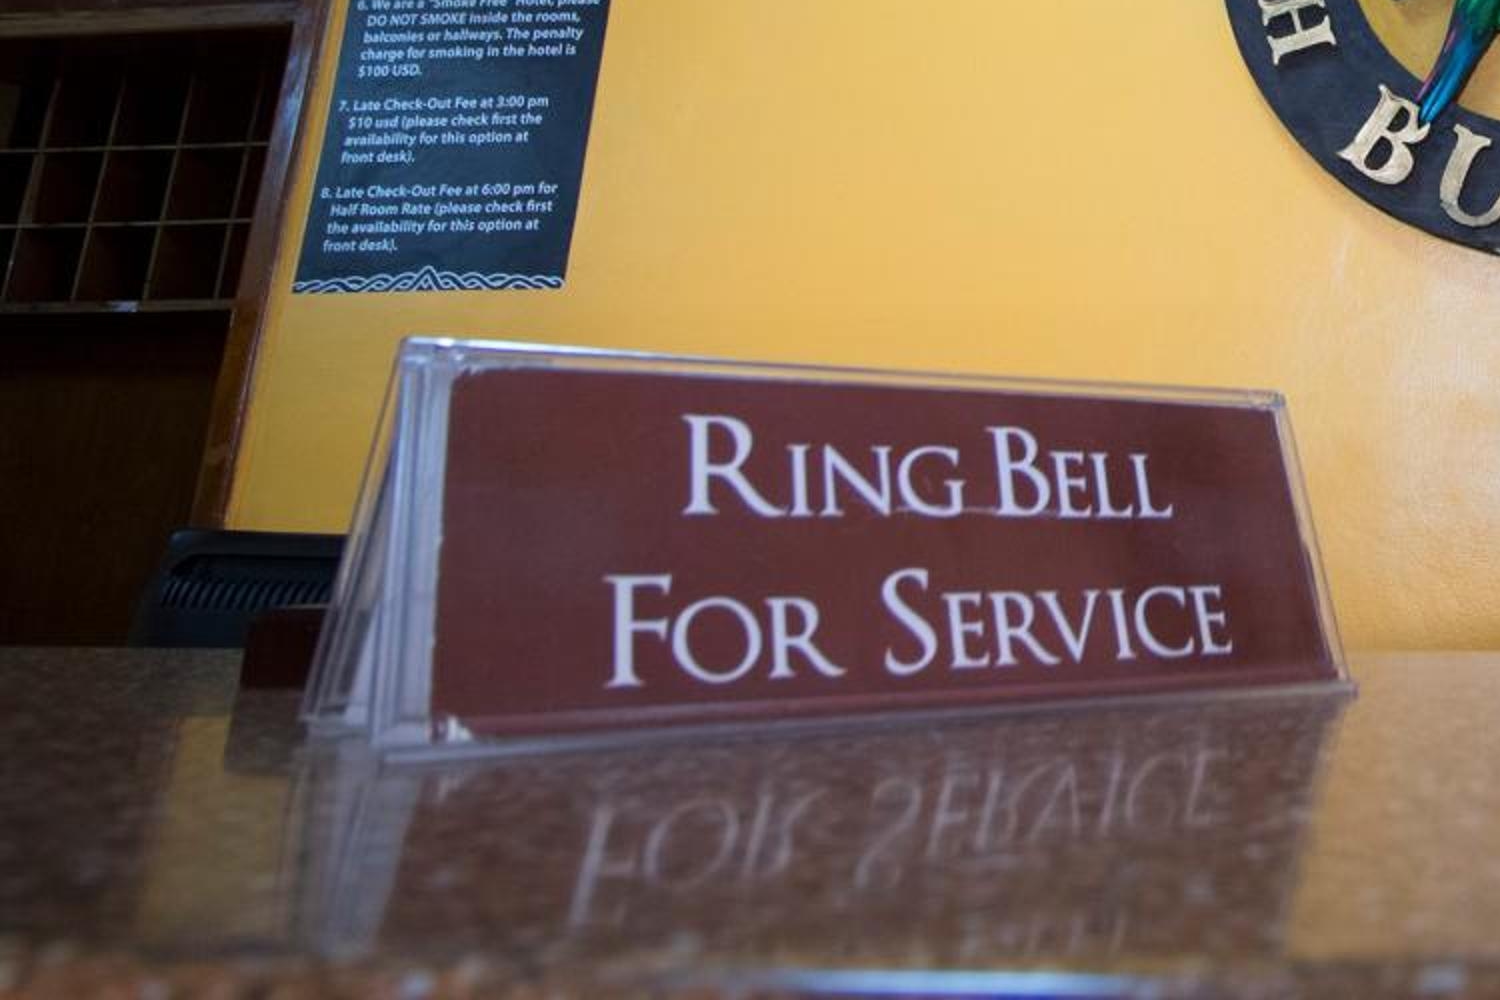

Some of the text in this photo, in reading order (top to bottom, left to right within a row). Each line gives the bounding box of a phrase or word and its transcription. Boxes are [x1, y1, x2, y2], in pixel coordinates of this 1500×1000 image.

[366, 11, 581, 27] DO NOT SMOKE inside the rooms,
[357, 63, 422, 79] $100 USD.
[338, 99, 350, 112] 7.
[352, 100, 382, 112] Late
[383, 97, 452, 111] Check-Out
[454, 96, 478, 109] Fee
[479, 96, 494, 109] at
[526, 97, 549, 110] pm
[347, 112, 543, 131] $10 usd (please check first the
[340, 150, 375, 163] front
[335, 186, 365, 199] Late
[366, 184, 437, 198] Check-Out
[438, 184, 463, 197] Fee
[464, 184, 479, 196] at
[480, 183, 511, 196] 6:00
[512, 184, 535, 197] pm
[537, 182, 559, 195] for
[329, 200, 553, 217] Half Room Rate (please check first
[322, 239, 357, 252] front
[682, 413, 1173, 519] RING BELL
[603, 567, 1233, 688] FOR SERVICE
